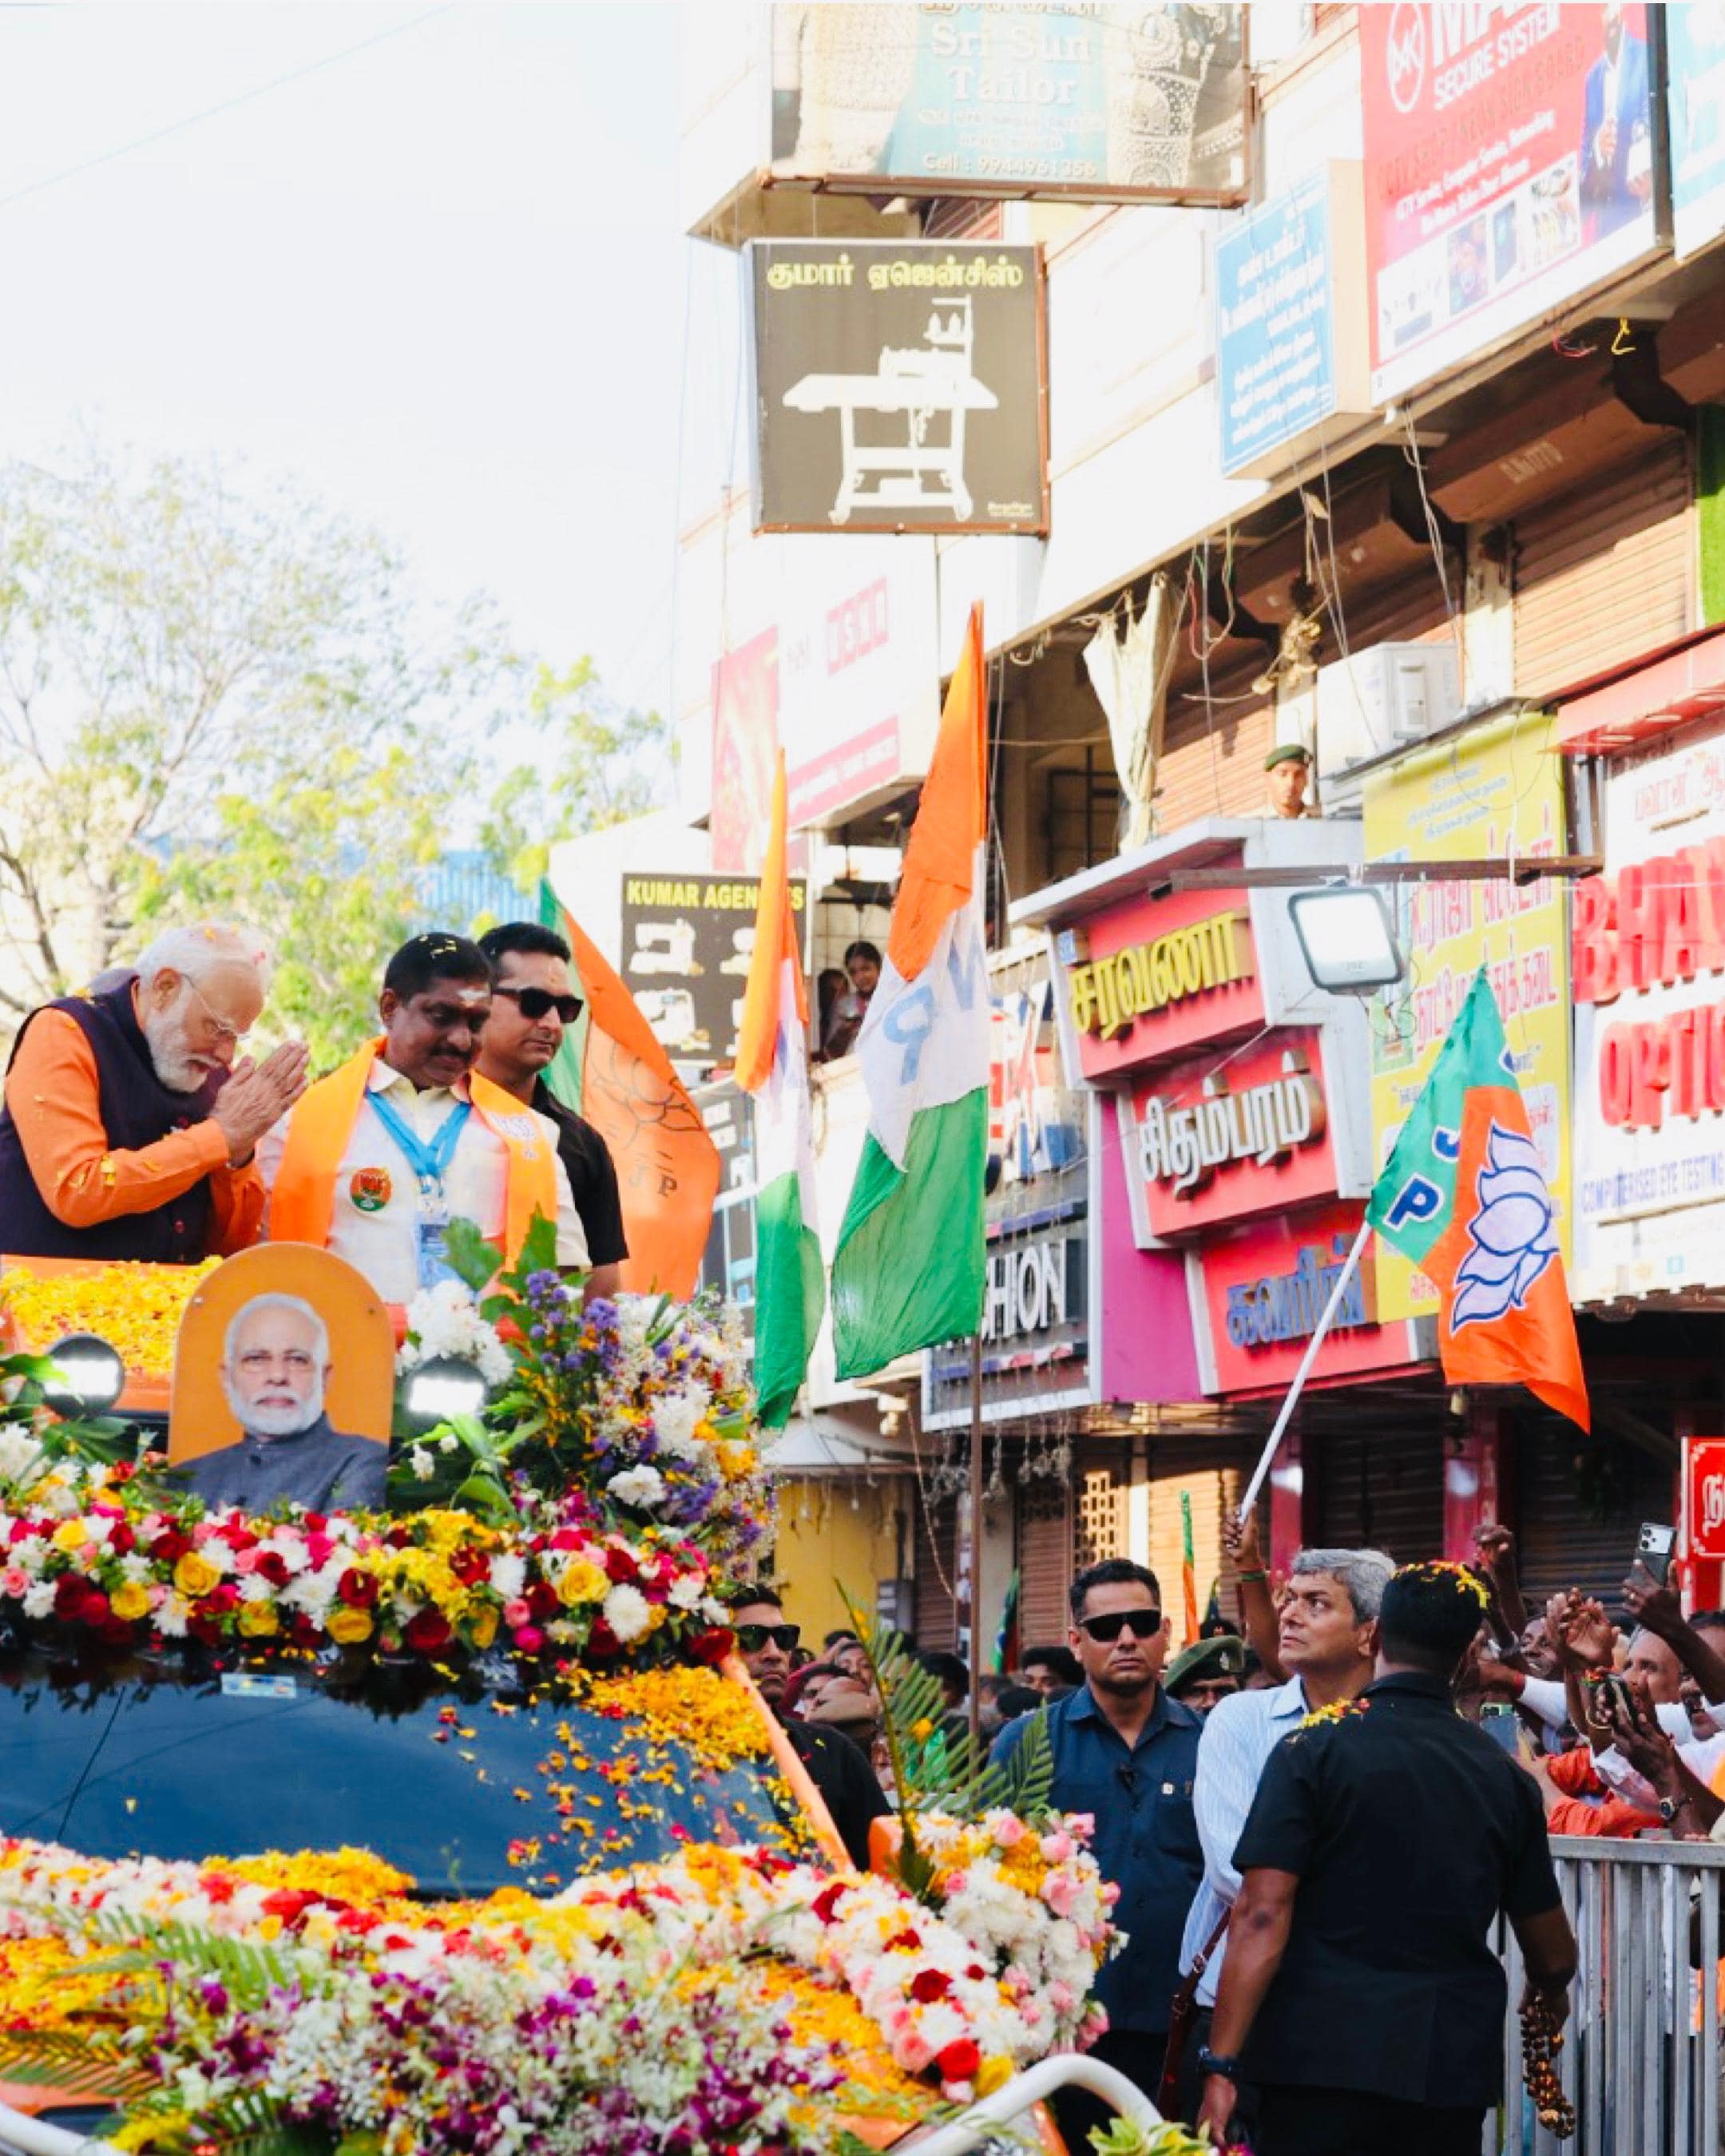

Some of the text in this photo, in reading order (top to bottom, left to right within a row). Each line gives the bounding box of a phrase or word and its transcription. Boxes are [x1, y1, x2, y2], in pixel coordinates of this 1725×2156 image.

[1009, 25, 1092, 62] Sun
[946, 65, 1078, 105] Tailor
[1434, 42, 1495, 112] SECURE
[767, 252, 855, 290] குமார்
[627, 878, 804, 910] KUMAR AGENS
[1069, 911, 1236, 1042] சரவணா
[1140, 1051, 1311, 1196] சிதம்பரம்
[1582, 1167, 1658, 1214] COMPUTERISED
[1660, 1160, 1679, 1196] EYE
[981, 1239, 1069, 1342] HION
